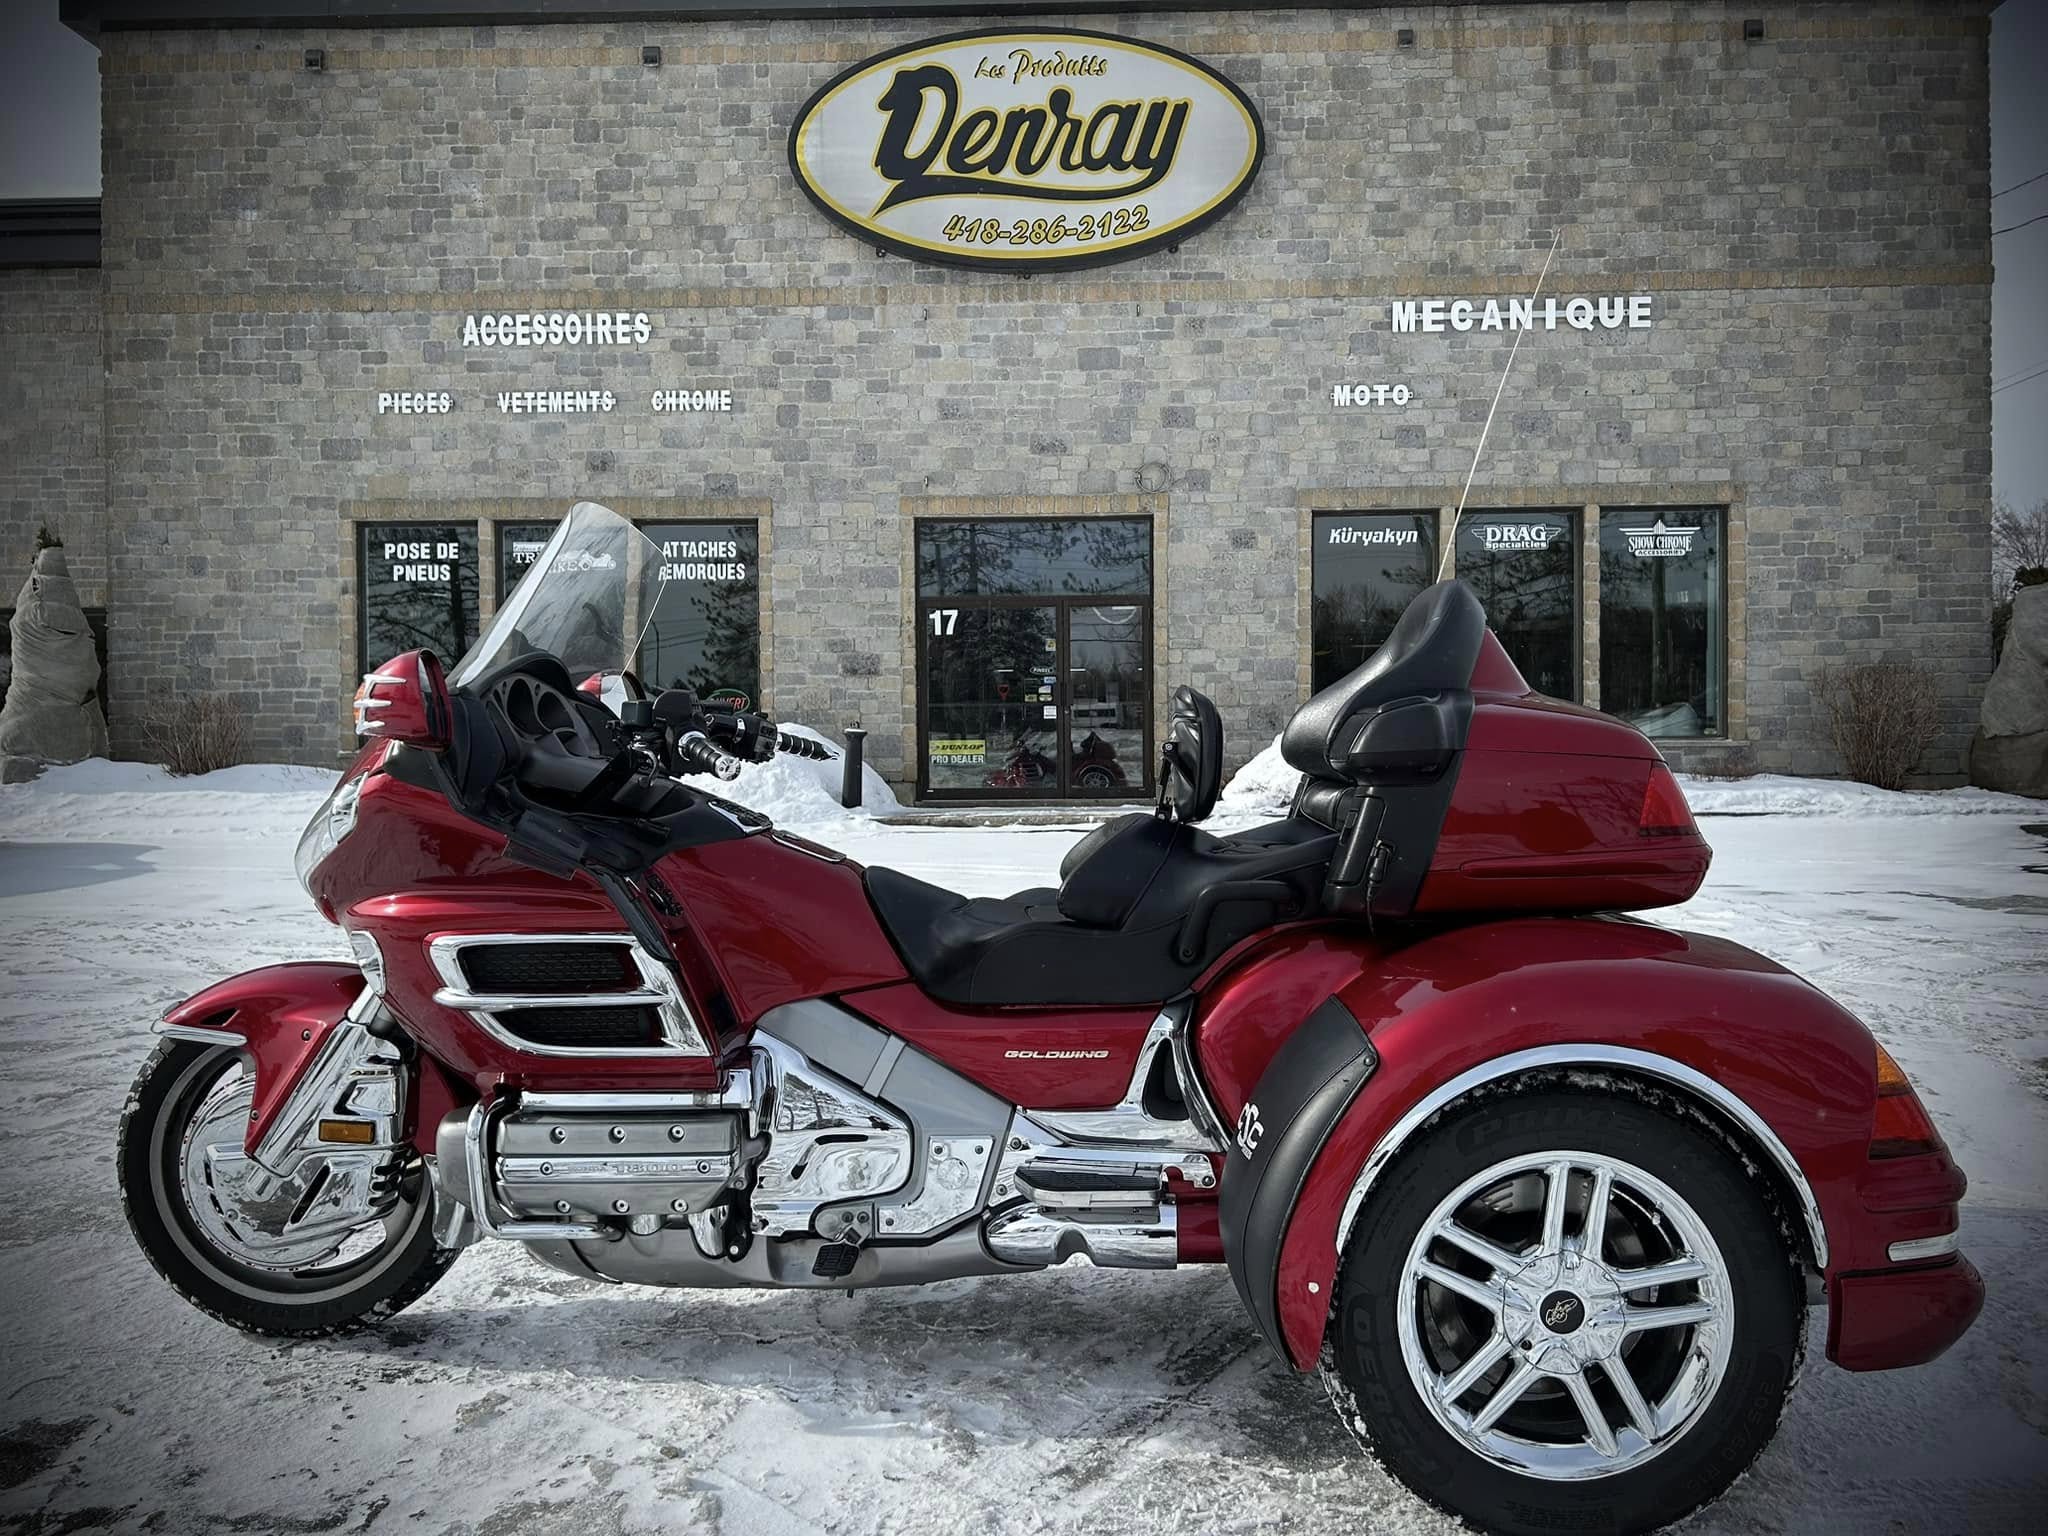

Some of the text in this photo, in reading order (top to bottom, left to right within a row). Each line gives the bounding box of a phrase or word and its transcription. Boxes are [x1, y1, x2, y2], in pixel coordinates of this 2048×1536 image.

[974, 48, 1109, 85] Les Produits
[872, 62, 1192, 216] Denray
[942, 204, 1150, 245] 418-286-2122
[1391, 296, 1652, 333] MECANIQUE
[463, 313, 652, 347] ACCESSOIRES
[378, 391, 452, 414] PIECES
[498, 390, 616, 414] VETEMENTS
[651, 389, 732, 412] CHROME
[1332, 384, 1411, 407] MOTO
[1486, 526, 1548, 541] DRAG
[1628, 536, 1693, 553] SHOW CHROME
[384, 542, 459, 560] POSE DE
[662, 541, 737, 558] ATTACHES
[1485, 540, 1547, 551] Specialties
[393, 564, 451, 582] PNEUS
[658, 563, 746, 582] REMORQUES
[929, 609, 958, 636] 17
[931, 754, 984, 765] PRO DEALER
[1004, 1050, 1109, 1059] GOLDWING
